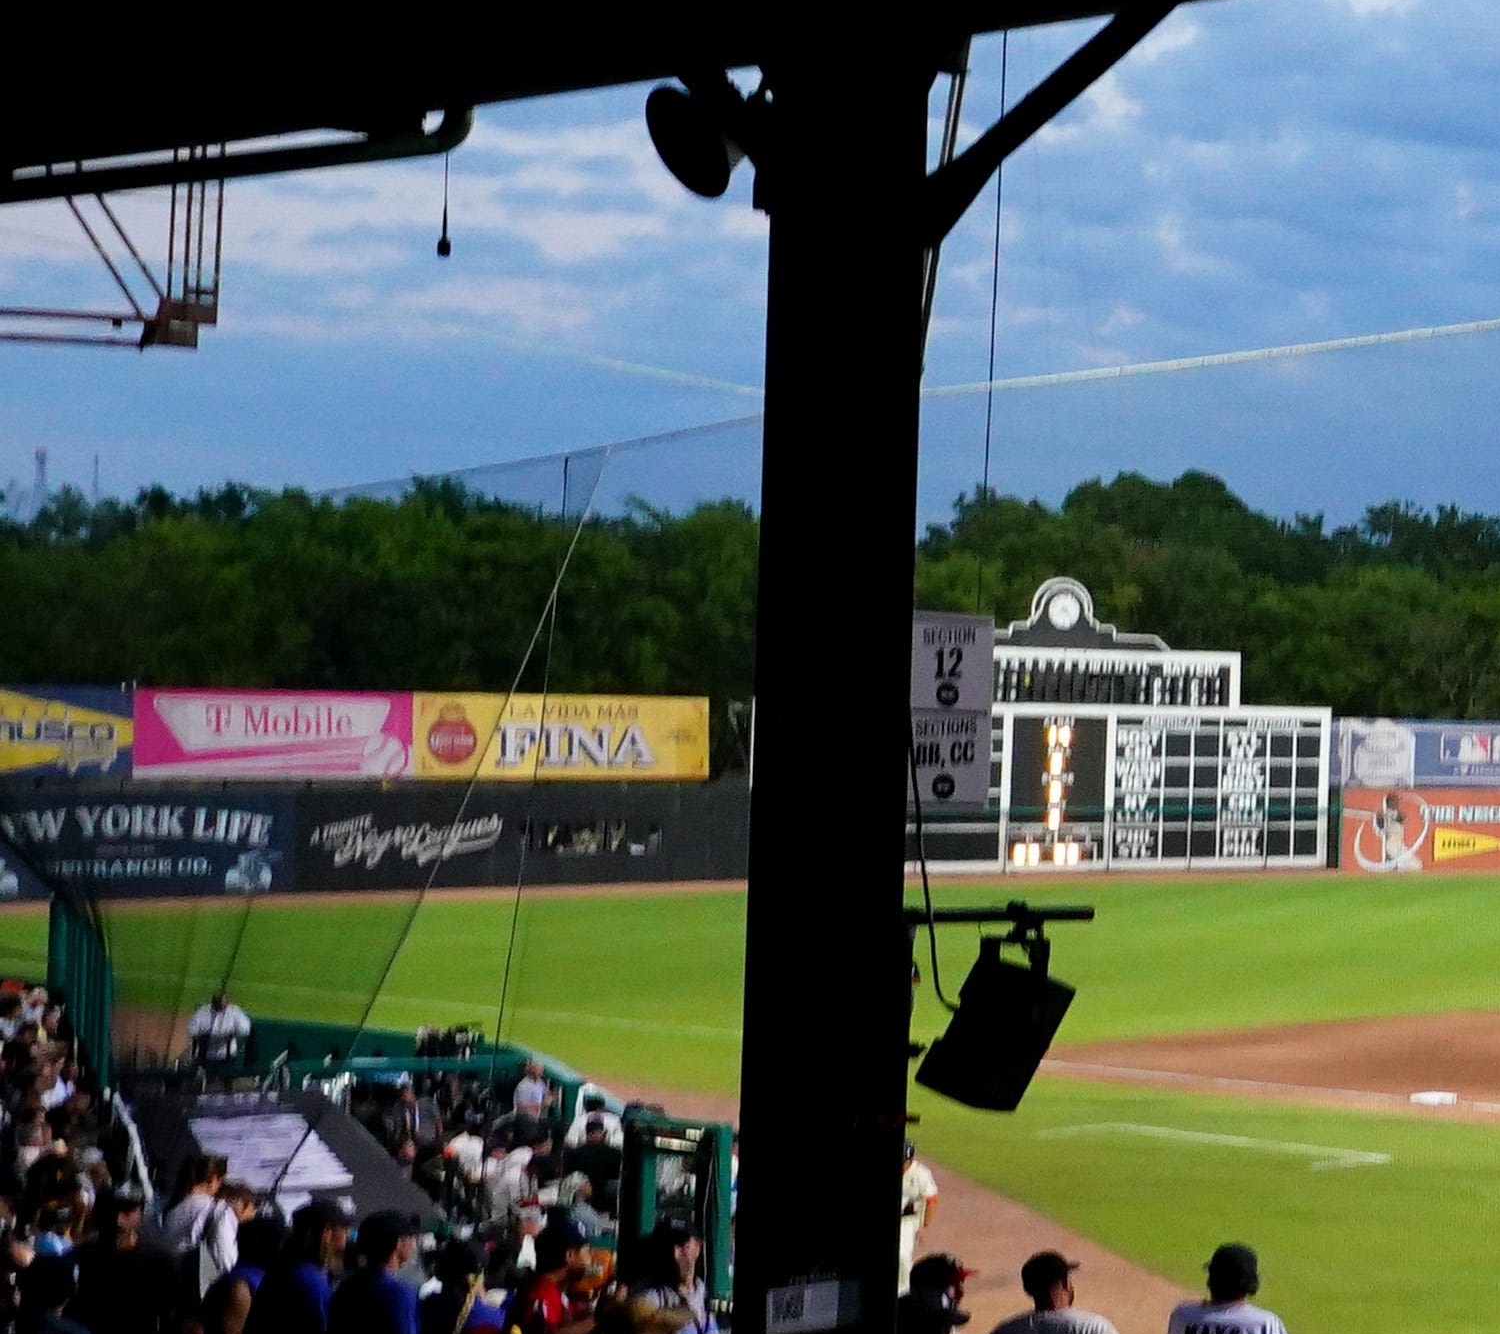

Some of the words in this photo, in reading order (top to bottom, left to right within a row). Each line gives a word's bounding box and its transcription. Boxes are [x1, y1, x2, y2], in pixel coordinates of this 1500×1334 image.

[923, 626, 977, 645] SECTION
[935, 646, 963, 679] 12
[244, 704, 353, 738] Mobile
[916, 718, 977, 740] SECTIONS
[497, 722, 658, 768] FINA
[950, 739, 976, 765] CC
[1124, 794, 1150, 812] NY
[75, 803, 187, 841] YORK
[191, 807, 274, 847] LIFE
[334, 823, 416, 871] Negro
[400, 813, 504, 867] Leagues
